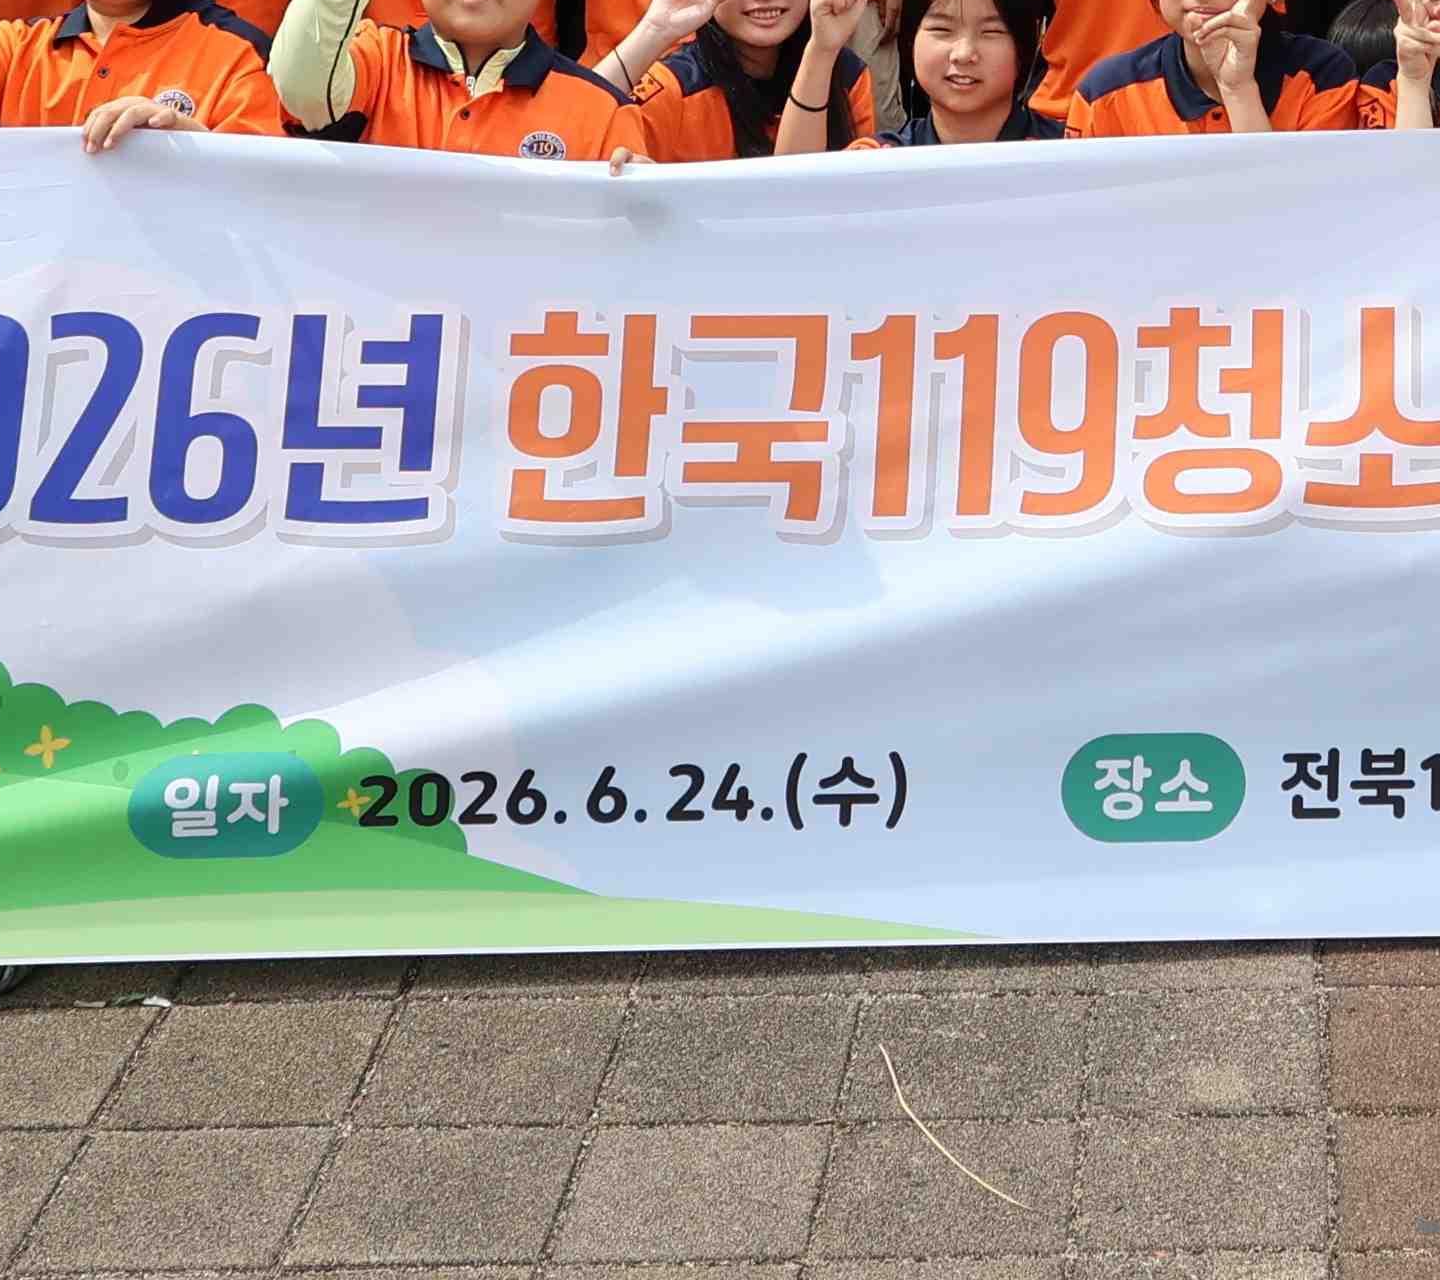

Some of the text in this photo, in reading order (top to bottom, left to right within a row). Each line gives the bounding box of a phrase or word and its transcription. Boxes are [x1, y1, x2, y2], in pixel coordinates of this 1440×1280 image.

[530, 140, 554, 155] 119
[163, 774, 289, 838] 일자
[1093, 755, 1213, 820] 장소
